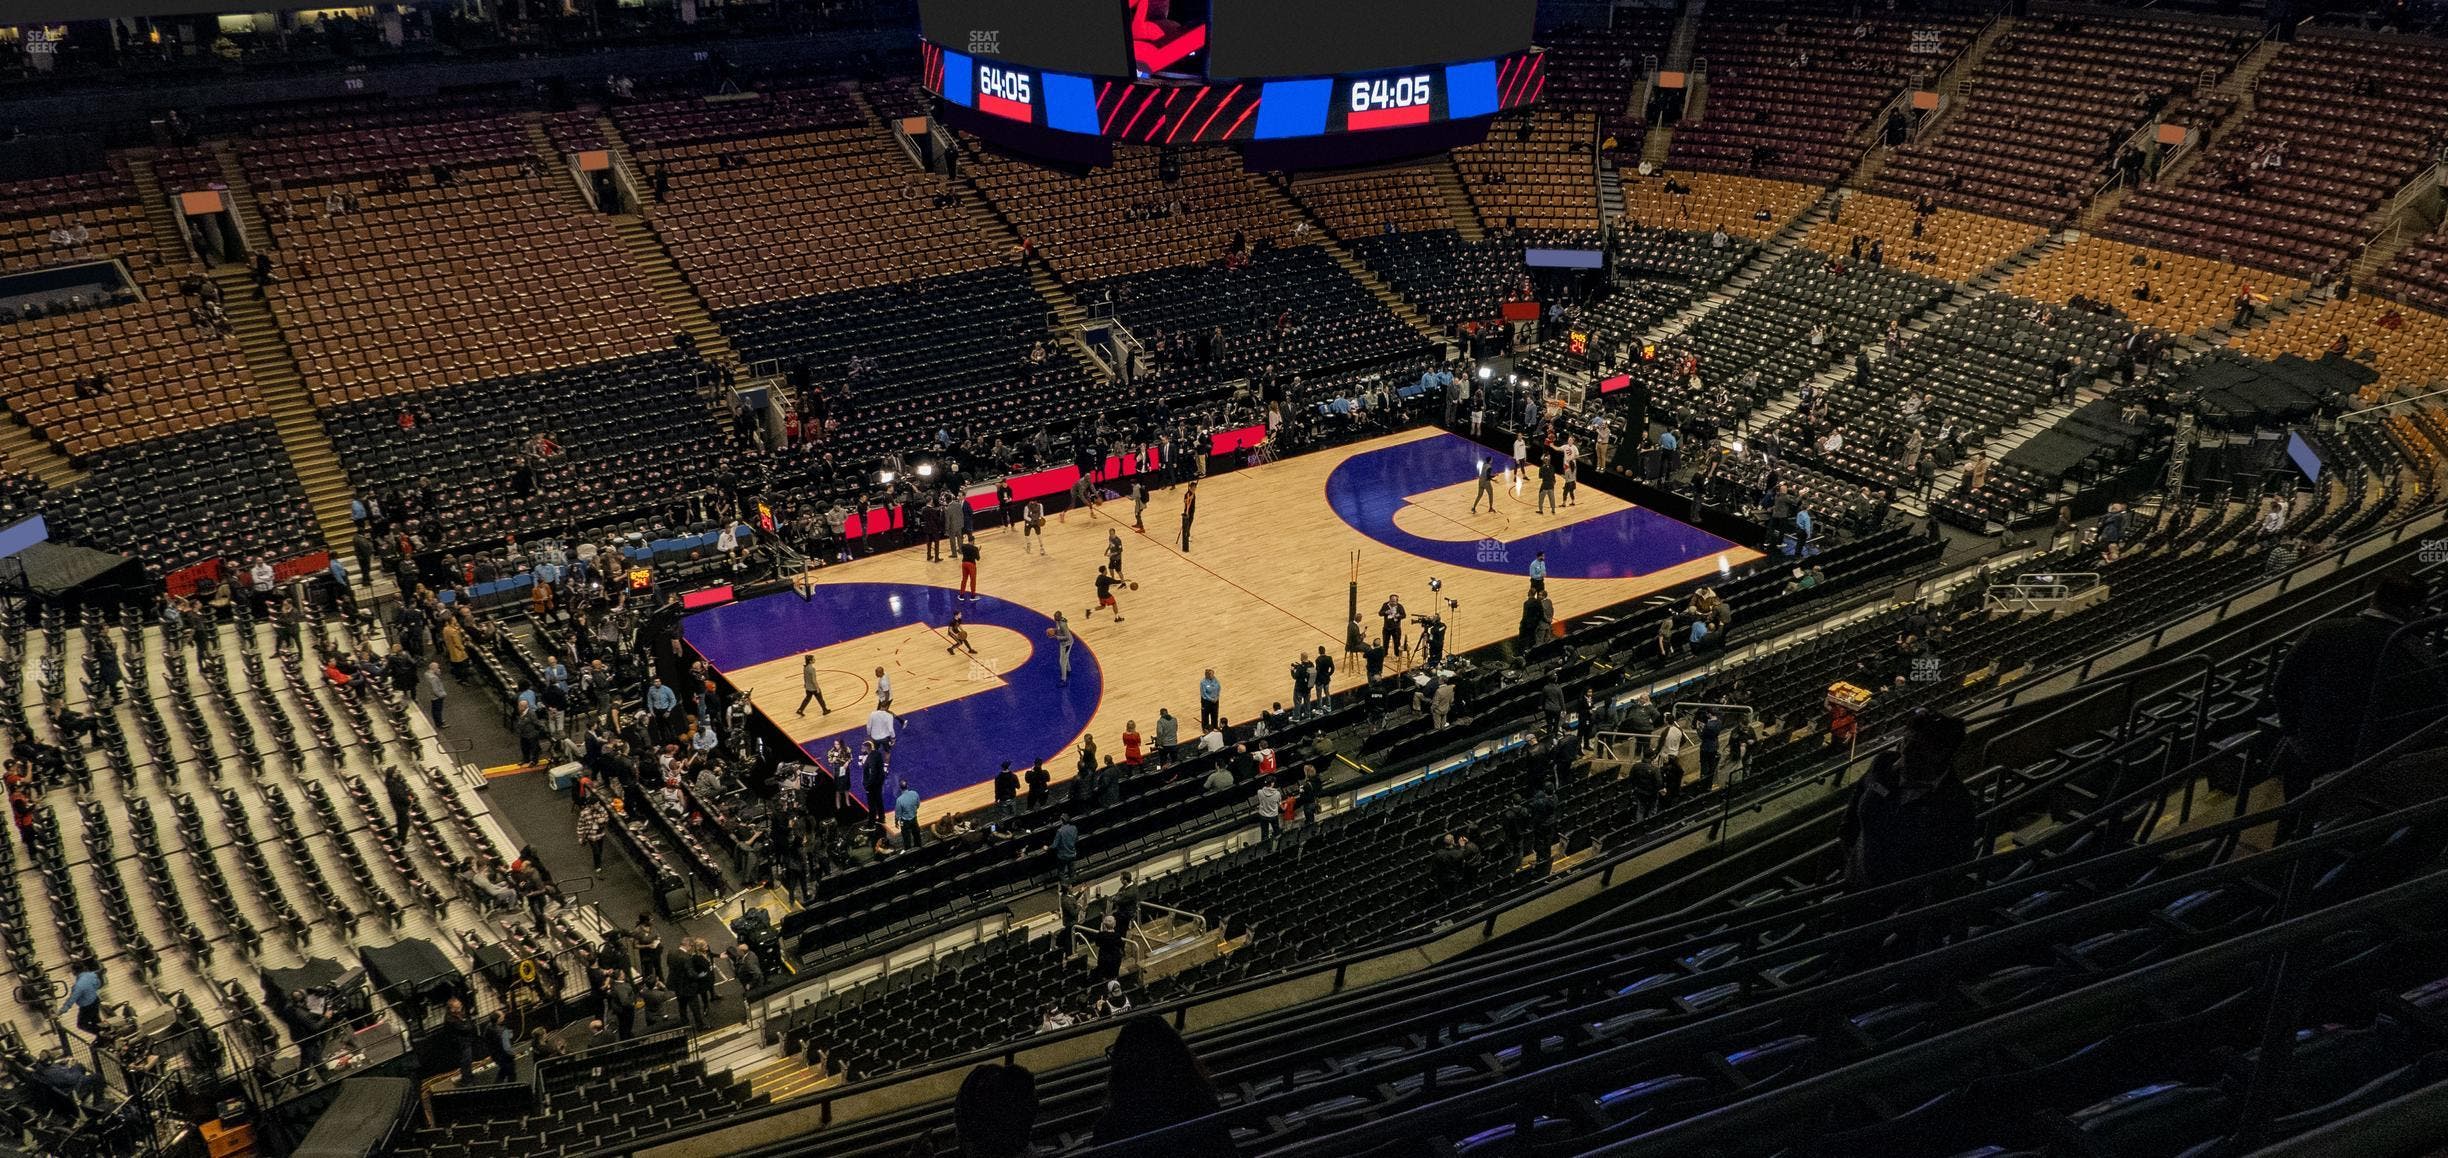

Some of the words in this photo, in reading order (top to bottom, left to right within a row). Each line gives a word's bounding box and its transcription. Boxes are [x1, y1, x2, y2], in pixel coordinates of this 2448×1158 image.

[980, 65, 1031, 104] 64:05
[1351, 74, 1431, 112] 64:05
[1571, 340, 1585, 354] 24
